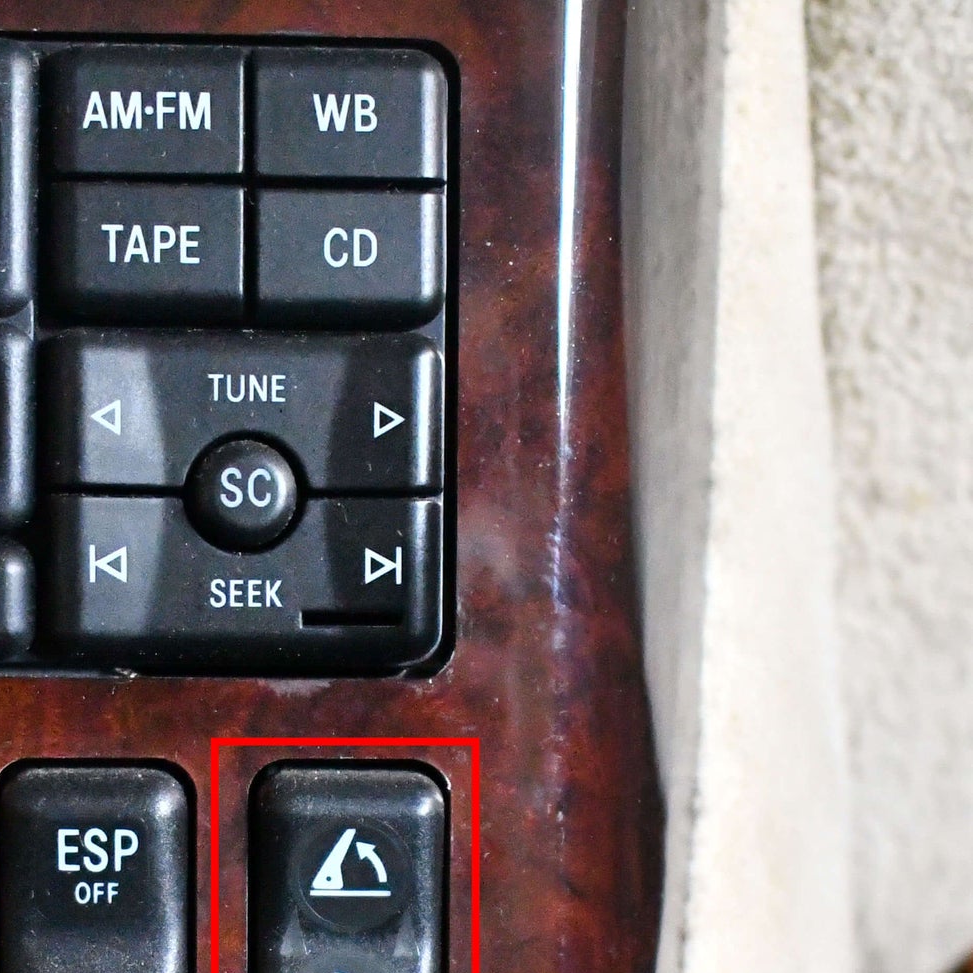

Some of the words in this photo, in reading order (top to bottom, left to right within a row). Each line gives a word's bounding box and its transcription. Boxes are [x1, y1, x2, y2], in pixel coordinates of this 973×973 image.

[312, 93, 378, 132] WB
[101, 224, 200, 264] TAPE
[323, 227, 378, 268] CD
[207, 373, 286, 403] TUNE
[219, 467, 273, 508] SC
[209, 578, 283, 608] SEEK
[57, 827, 139, 873] ESP
[74, 881, 119, 905] OFF
